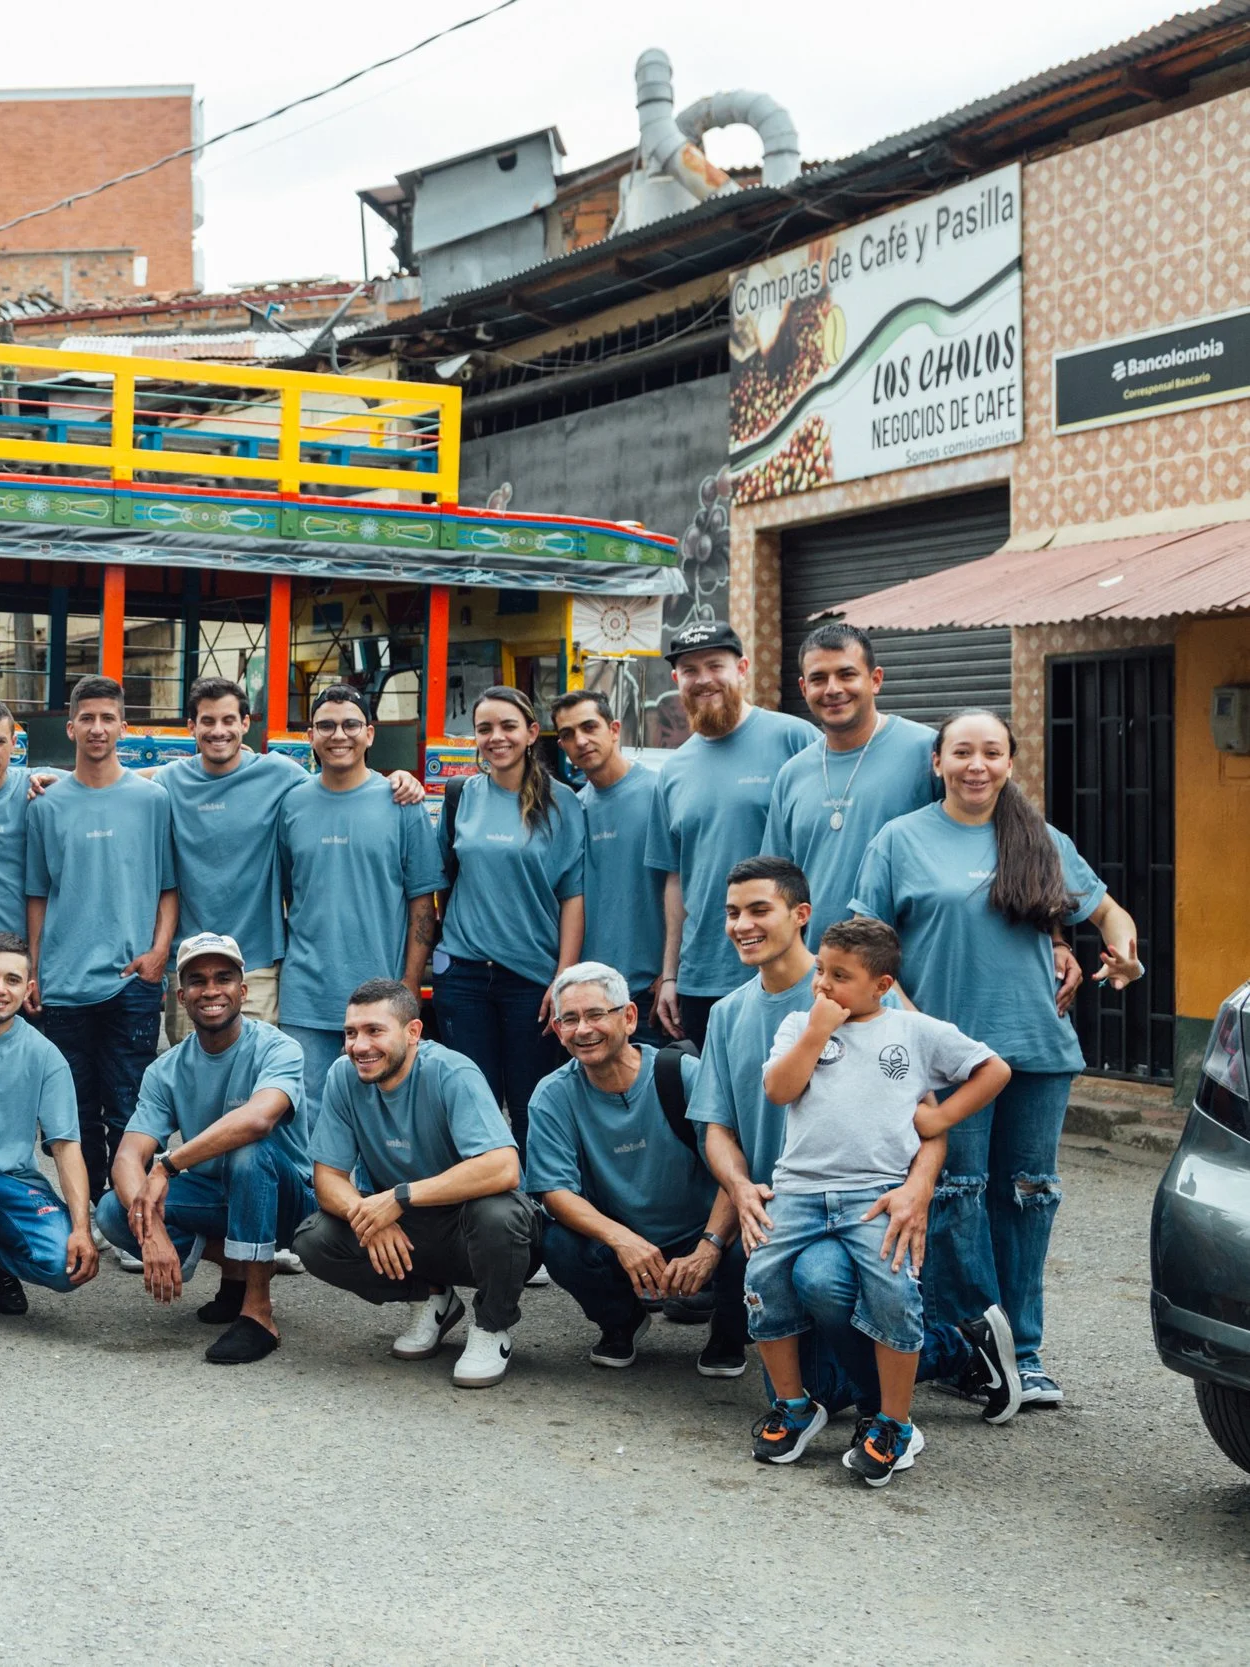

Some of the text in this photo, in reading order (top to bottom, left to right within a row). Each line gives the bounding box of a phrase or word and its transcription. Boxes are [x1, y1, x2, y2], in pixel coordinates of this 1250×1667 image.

[734, 187, 1014, 316] Compras de Café y Pasilla
[873, 324, 1015, 405] LOS CHOLOS
[1128, 338, 1224, 377] Bancolombia
[872, 377, 1016, 450] NEGOCIOS DE CAFÉ
[1123, 372, 1211, 400] Corresponsal Bancario
[906, 429, 1017, 464] Somos comisionistas
